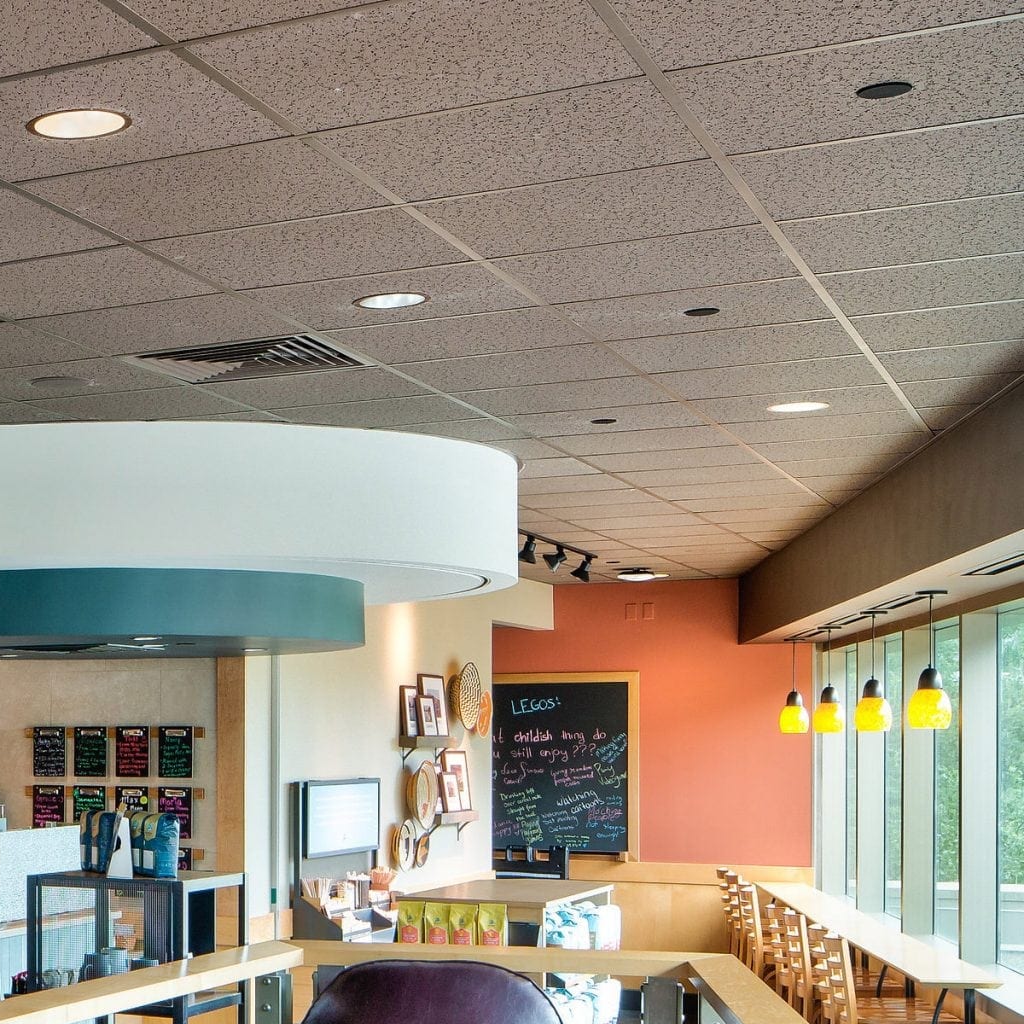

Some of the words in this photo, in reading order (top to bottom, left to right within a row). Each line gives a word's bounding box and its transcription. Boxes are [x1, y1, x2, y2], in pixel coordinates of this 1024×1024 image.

[514, 728, 553, 743] childish
[561, 730, 585, 745] thing
[592, 728, 606, 741] do
[510, 748, 532, 759] still
[540, 747, 568, 764] enjoy
[572, 743, 596, 758] ???
[556, 790, 600, 806] watching
[570, 799, 605, 814] cartoons
